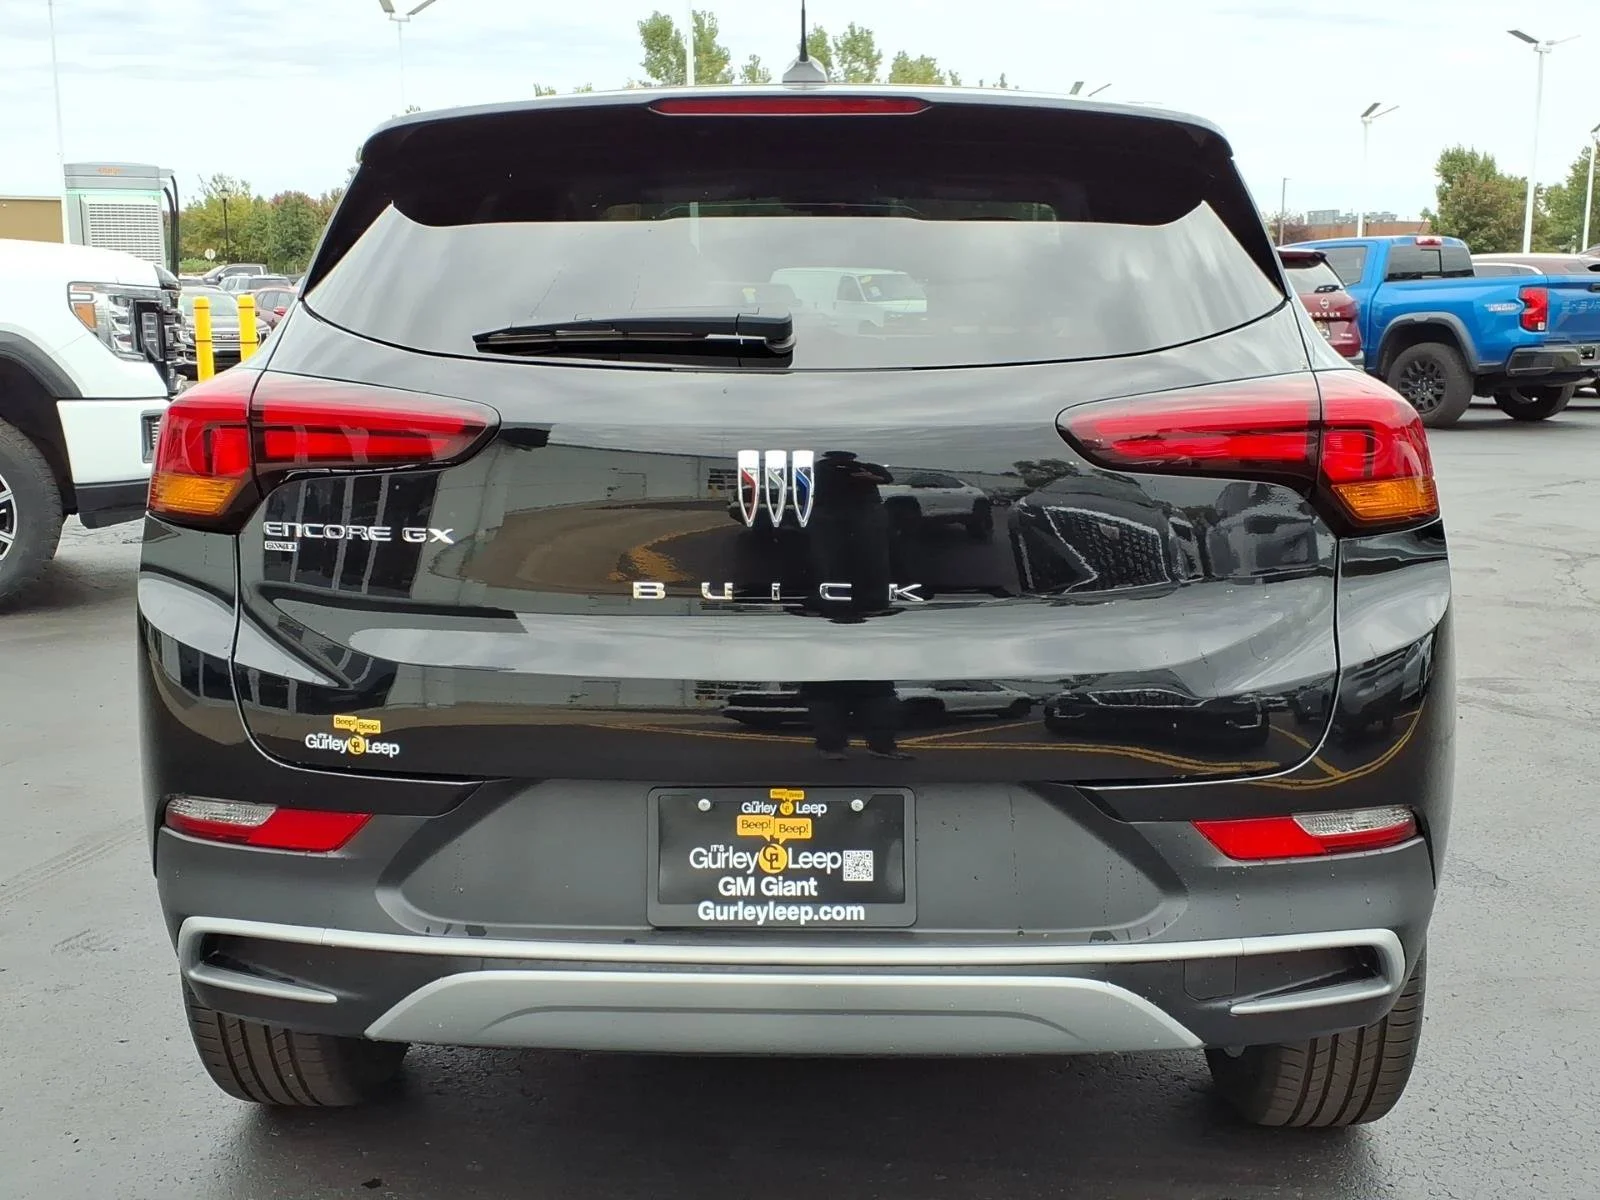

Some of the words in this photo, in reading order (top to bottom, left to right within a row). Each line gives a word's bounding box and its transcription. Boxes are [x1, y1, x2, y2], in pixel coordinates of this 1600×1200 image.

[263, 521, 392, 541] ENCORE
[402, 527, 454, 544] GX
[633, 582, 924, 601] BUICK
[335, 717, 356, 727] Beep!
[358, 721, 379, 732] Beep!
[305, 734, 348, 754] Gurley
[365, 739, 400, 758] Leep
[741, 801, 777, 816] Gurley
[795, 801, 827, 817] Leep
[741, 820, 771, 832] Beep!
[779, 823, 809, 836] Beep!
[689, 846, 760, 874] Gurley
[787, 847, 842, 874] Leep
[718, 876, 755, 897] GM
[760, 876, 818, 897] Giant
[697, 900, 866, 926] Gurleyleep.com
